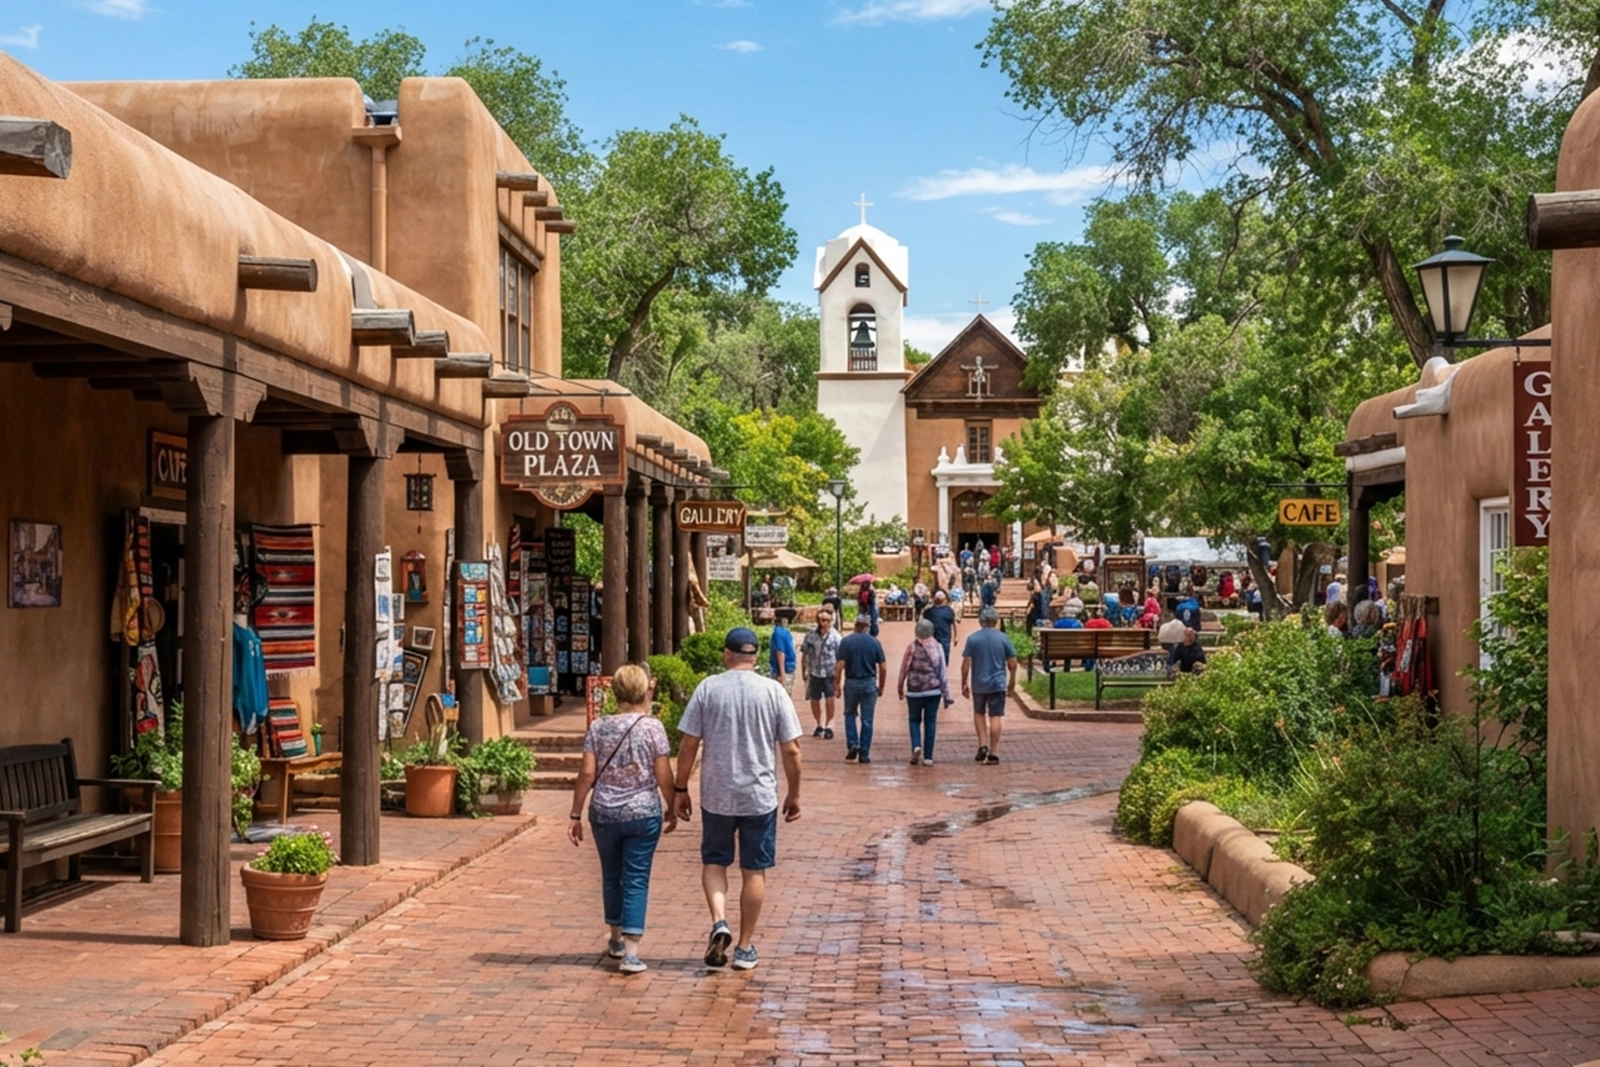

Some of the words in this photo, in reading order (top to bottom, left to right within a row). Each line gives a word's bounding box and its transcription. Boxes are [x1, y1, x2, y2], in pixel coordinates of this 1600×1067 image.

[508, 431, 549, 451] OLD
[555, 431, 614, 451] TOWN
[524, 454, 601, 476] PLAZA
[1283, 502, 1338, 522] CAFE
